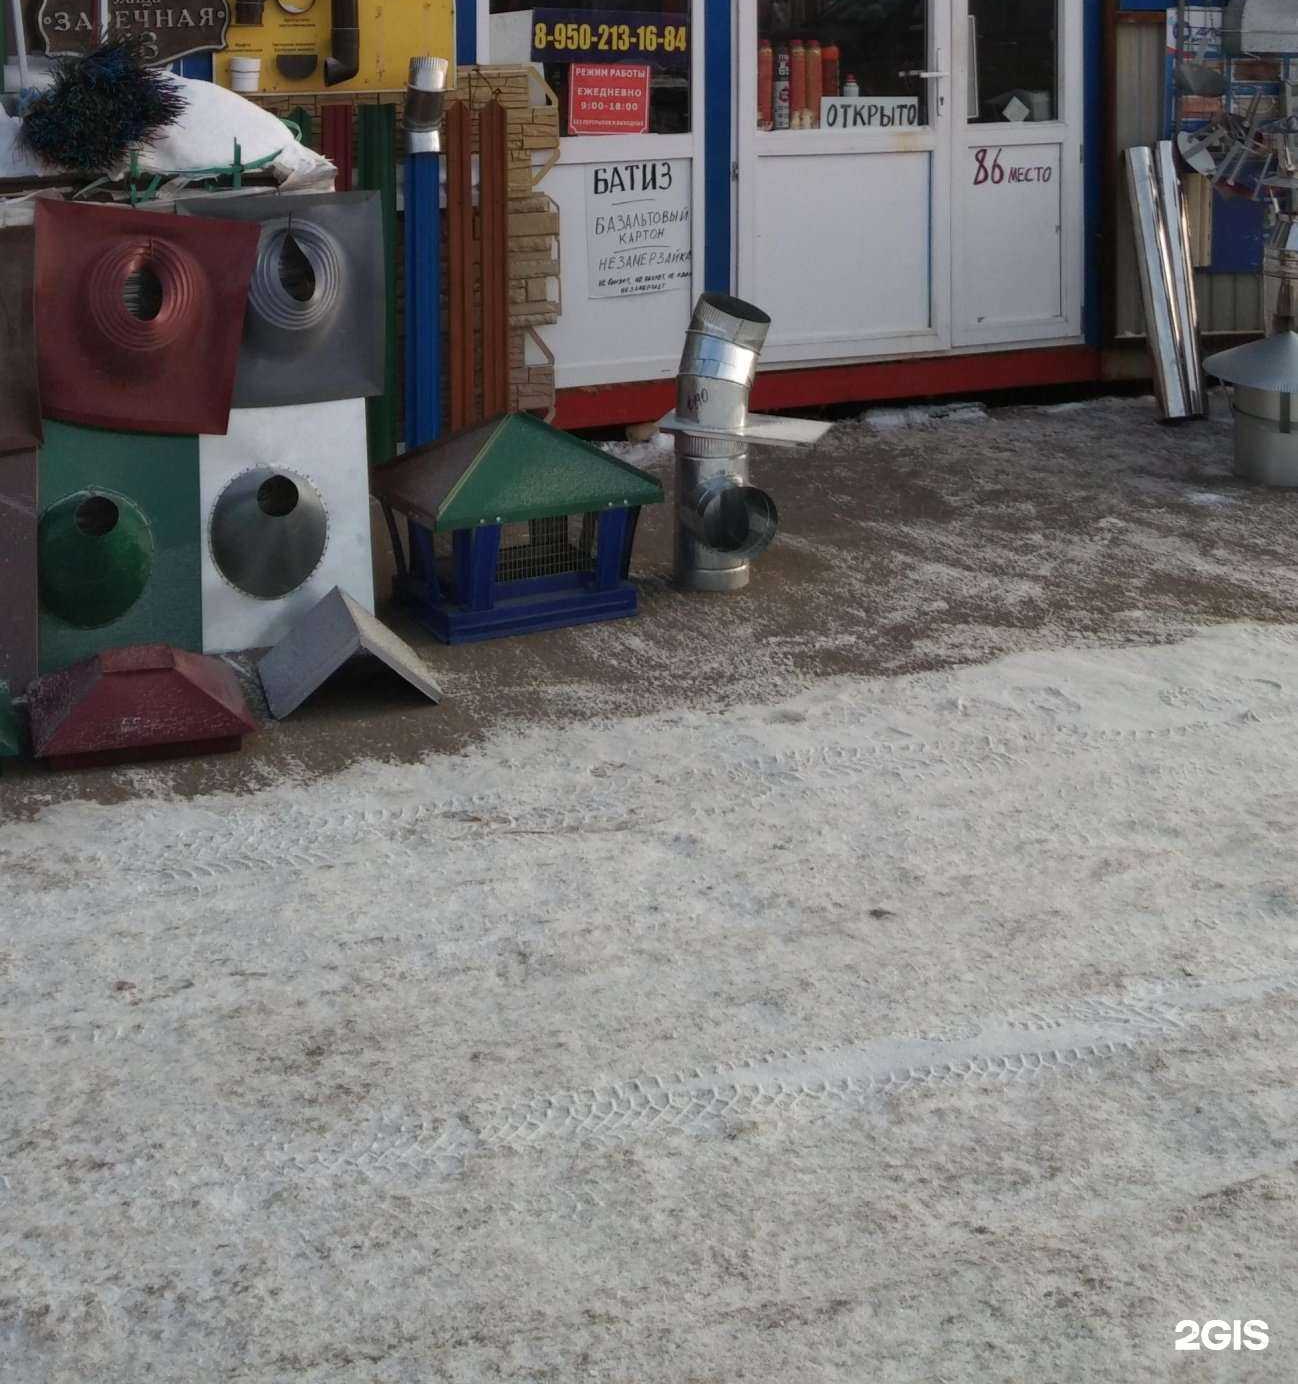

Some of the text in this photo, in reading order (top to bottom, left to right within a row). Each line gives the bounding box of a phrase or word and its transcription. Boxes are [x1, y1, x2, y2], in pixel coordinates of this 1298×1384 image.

[54, 7, 215, 32] ЗАЕЧНАЯ
[533, 22, 688, 52] 8-950-213-16-84
[575, 67, 646, 78] РЕЖИМ РАБОТЫ
[577, 87, 642, 98] ЕЖЕДНЕВНО
[826, 102, 918, 128] ОТКРЫТО
[593, 161, 673, 195] БАТИЗ
[973, 148, 1051, 185] 86 МЕСТО
[594, 206, 689, 235] БАЗАЛЬТОВЫЙ
[619, 228, 665, 245] КАРТОН
